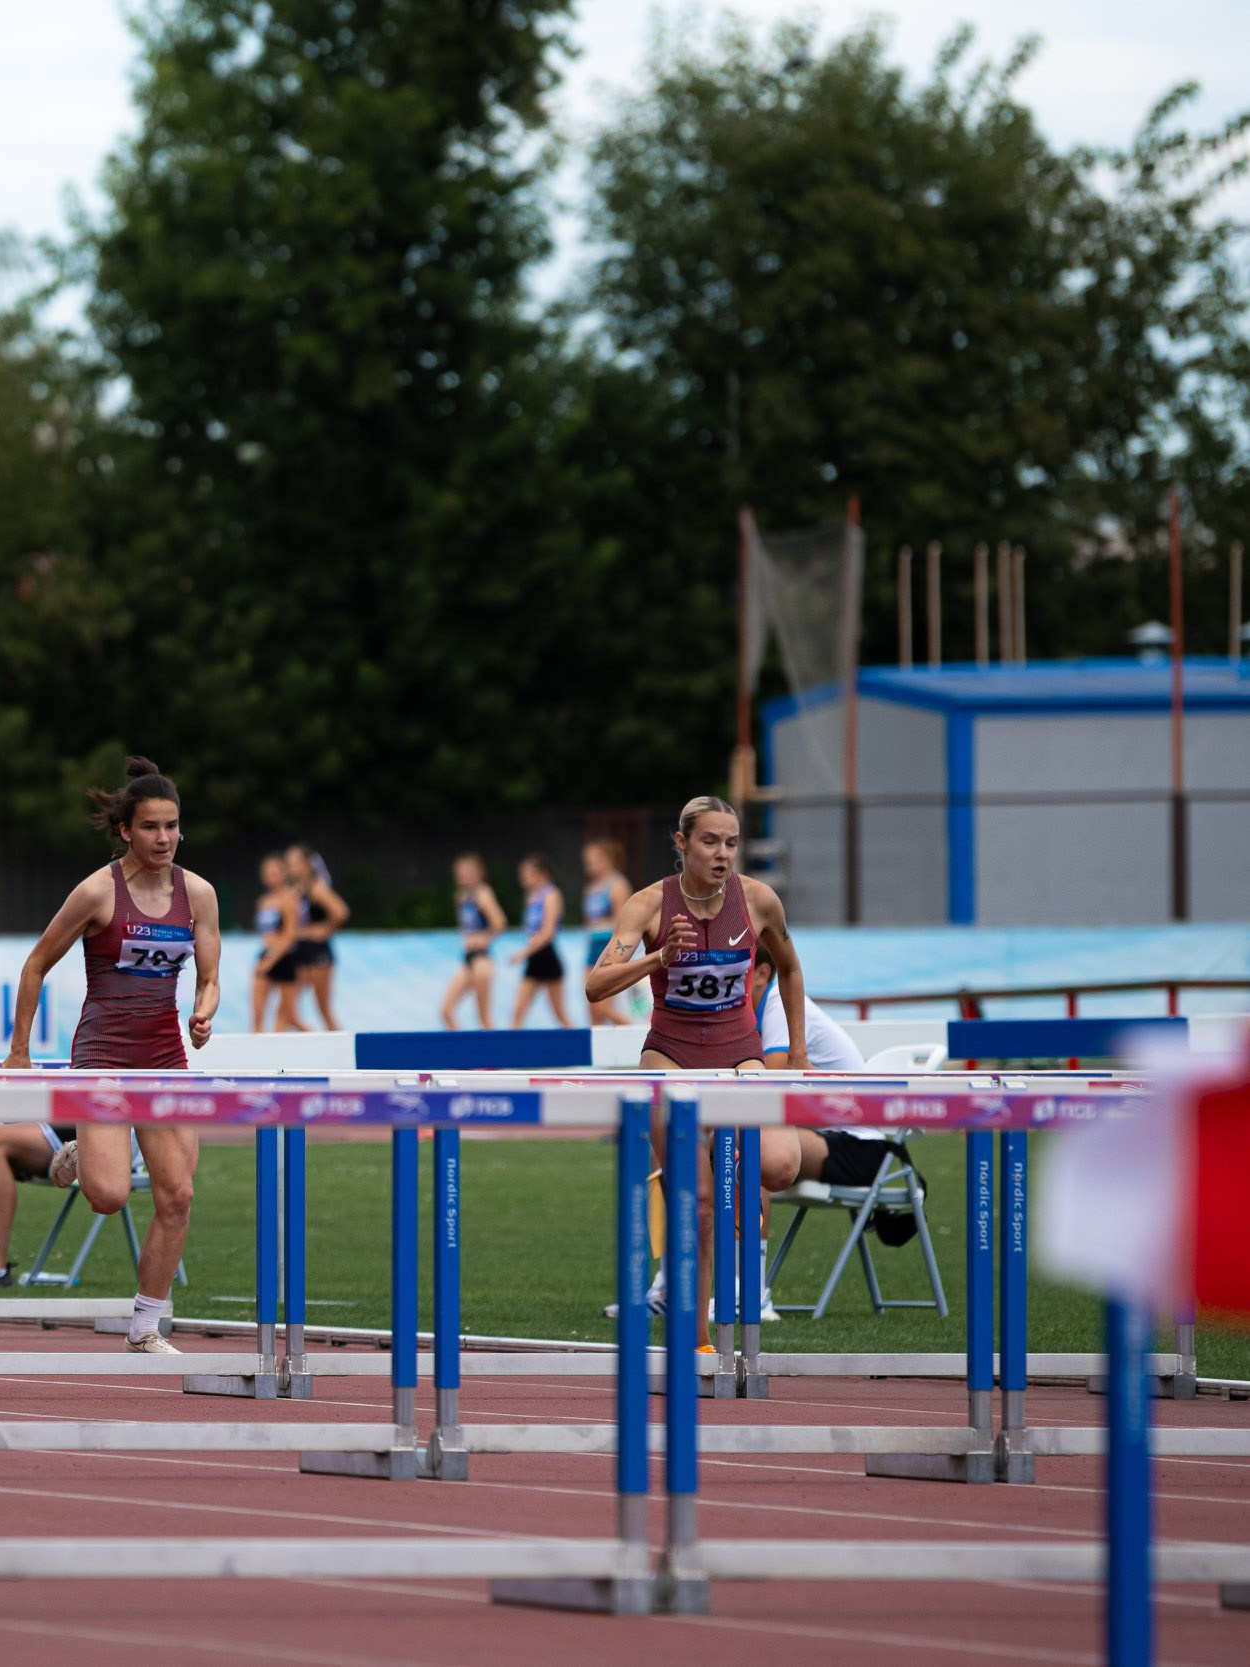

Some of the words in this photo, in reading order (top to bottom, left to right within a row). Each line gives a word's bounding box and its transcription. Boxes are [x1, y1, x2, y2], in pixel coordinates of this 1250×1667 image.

[127, 925, 151, 937] U23
[675, 974, 743, 1000] 587
[723, 1176, 733, 1210] Sport
[445, 1207, 458, 1248] Sport
[978, 1210, 990, 1251] Sport
[1012, 1211, 1024, 1253] Sport
